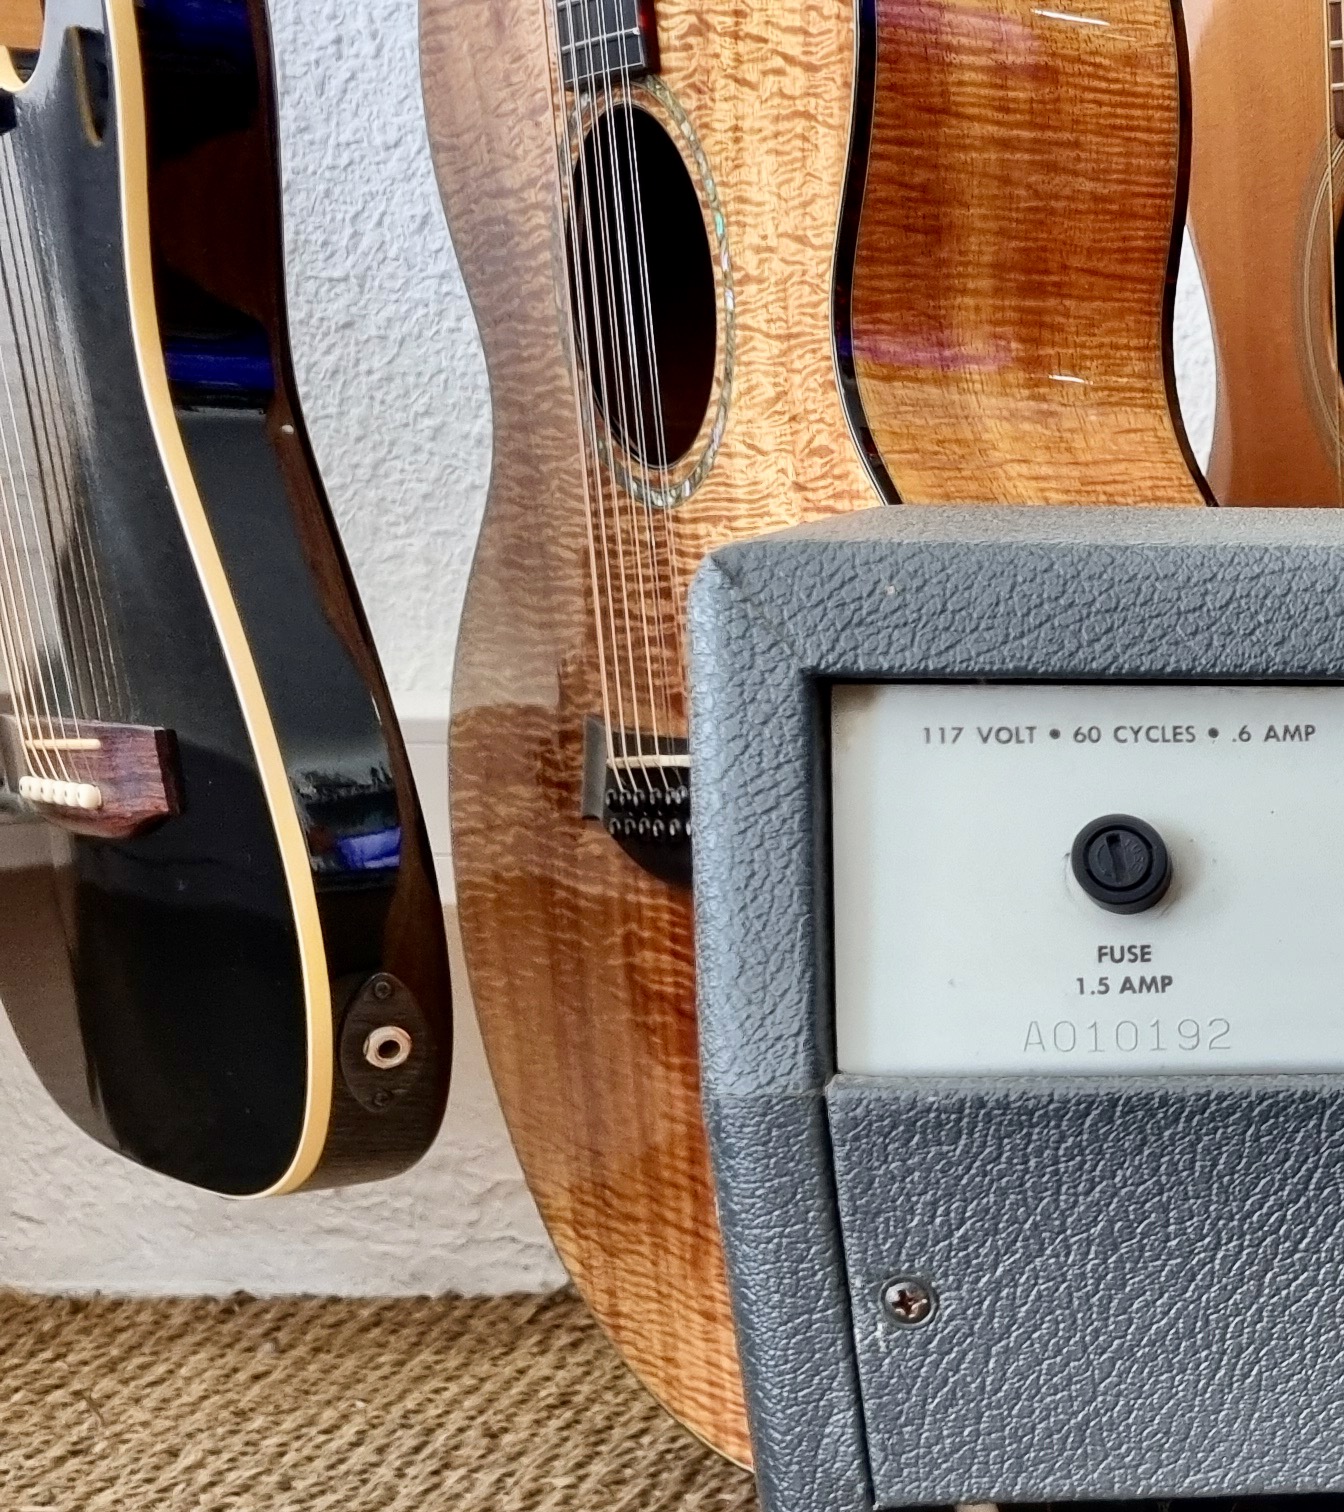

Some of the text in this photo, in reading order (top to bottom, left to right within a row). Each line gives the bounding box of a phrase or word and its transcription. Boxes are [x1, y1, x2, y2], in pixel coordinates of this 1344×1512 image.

[923, 724, 1317, 745] 117 VOLT 60 CYCLES .6 AMP
[1096, 944, 1153, 965] FUSE
[1075, 974, 1174, 996] 1.5 AMP
[1023, 1017, 1232, 1053] A010192
